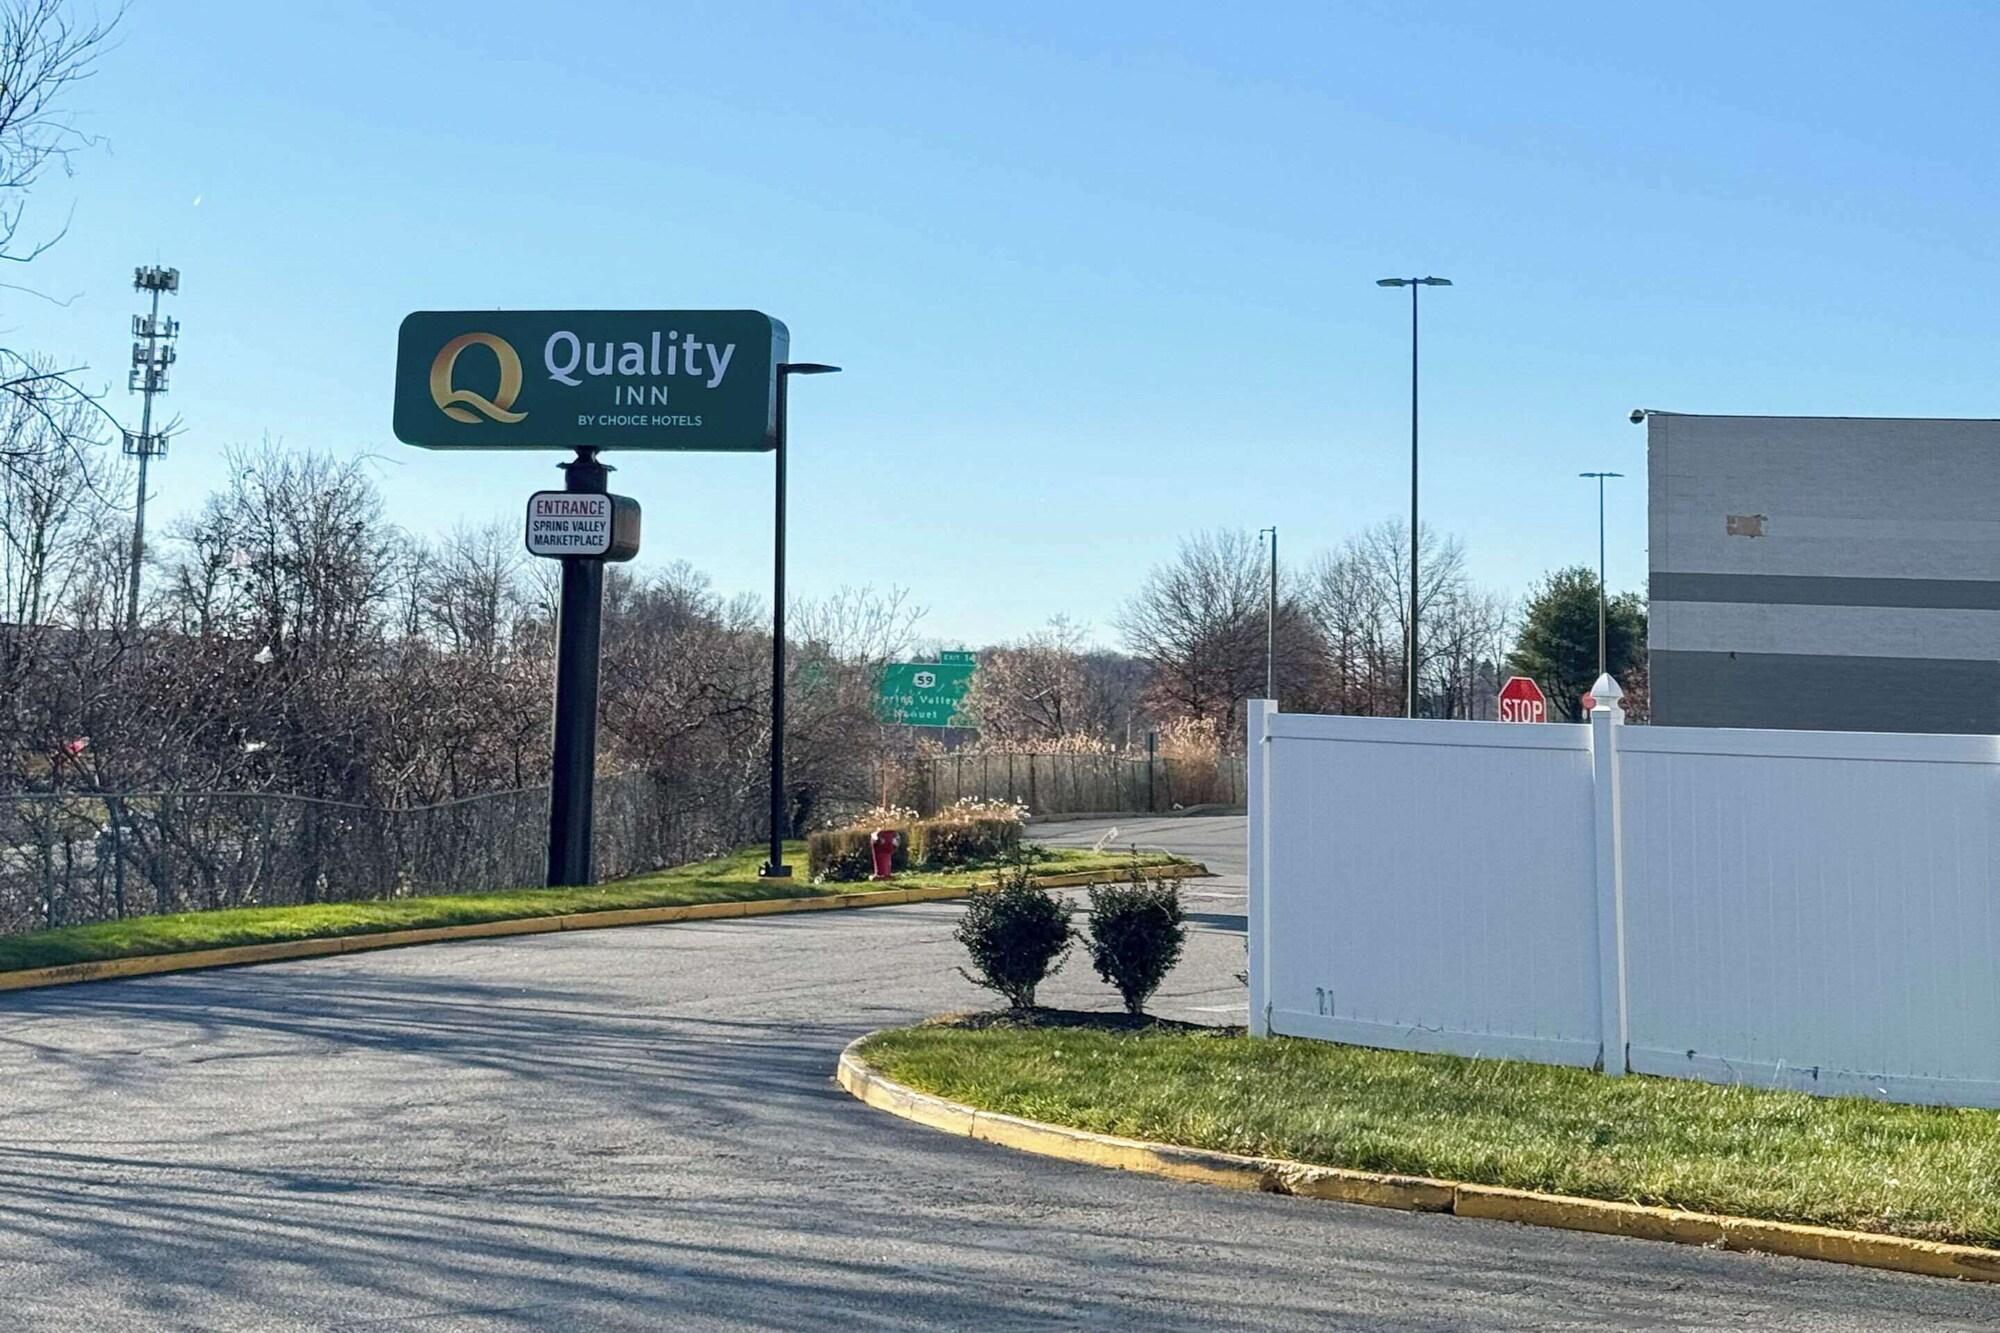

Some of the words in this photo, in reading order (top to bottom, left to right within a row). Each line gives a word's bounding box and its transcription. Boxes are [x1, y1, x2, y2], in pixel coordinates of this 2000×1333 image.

[544, 330, 736, 389] Quality
[615, 386, 669, 406] INN
[578, 415, 596, 426] BY
[599, 415, 649, 426] CHOICE
[652, 415, 703, 426] HOTELS
[536, 500, 605, 515] ENTRANCE
[533, 520, 569, 532] SPRING
[572, 520, 606, 532] VALLEY
[534, 534, 604, 546] MARKETPLACE
[917, 676, 934, 686] 59
[1502, 698, 1543, 723] STOP
